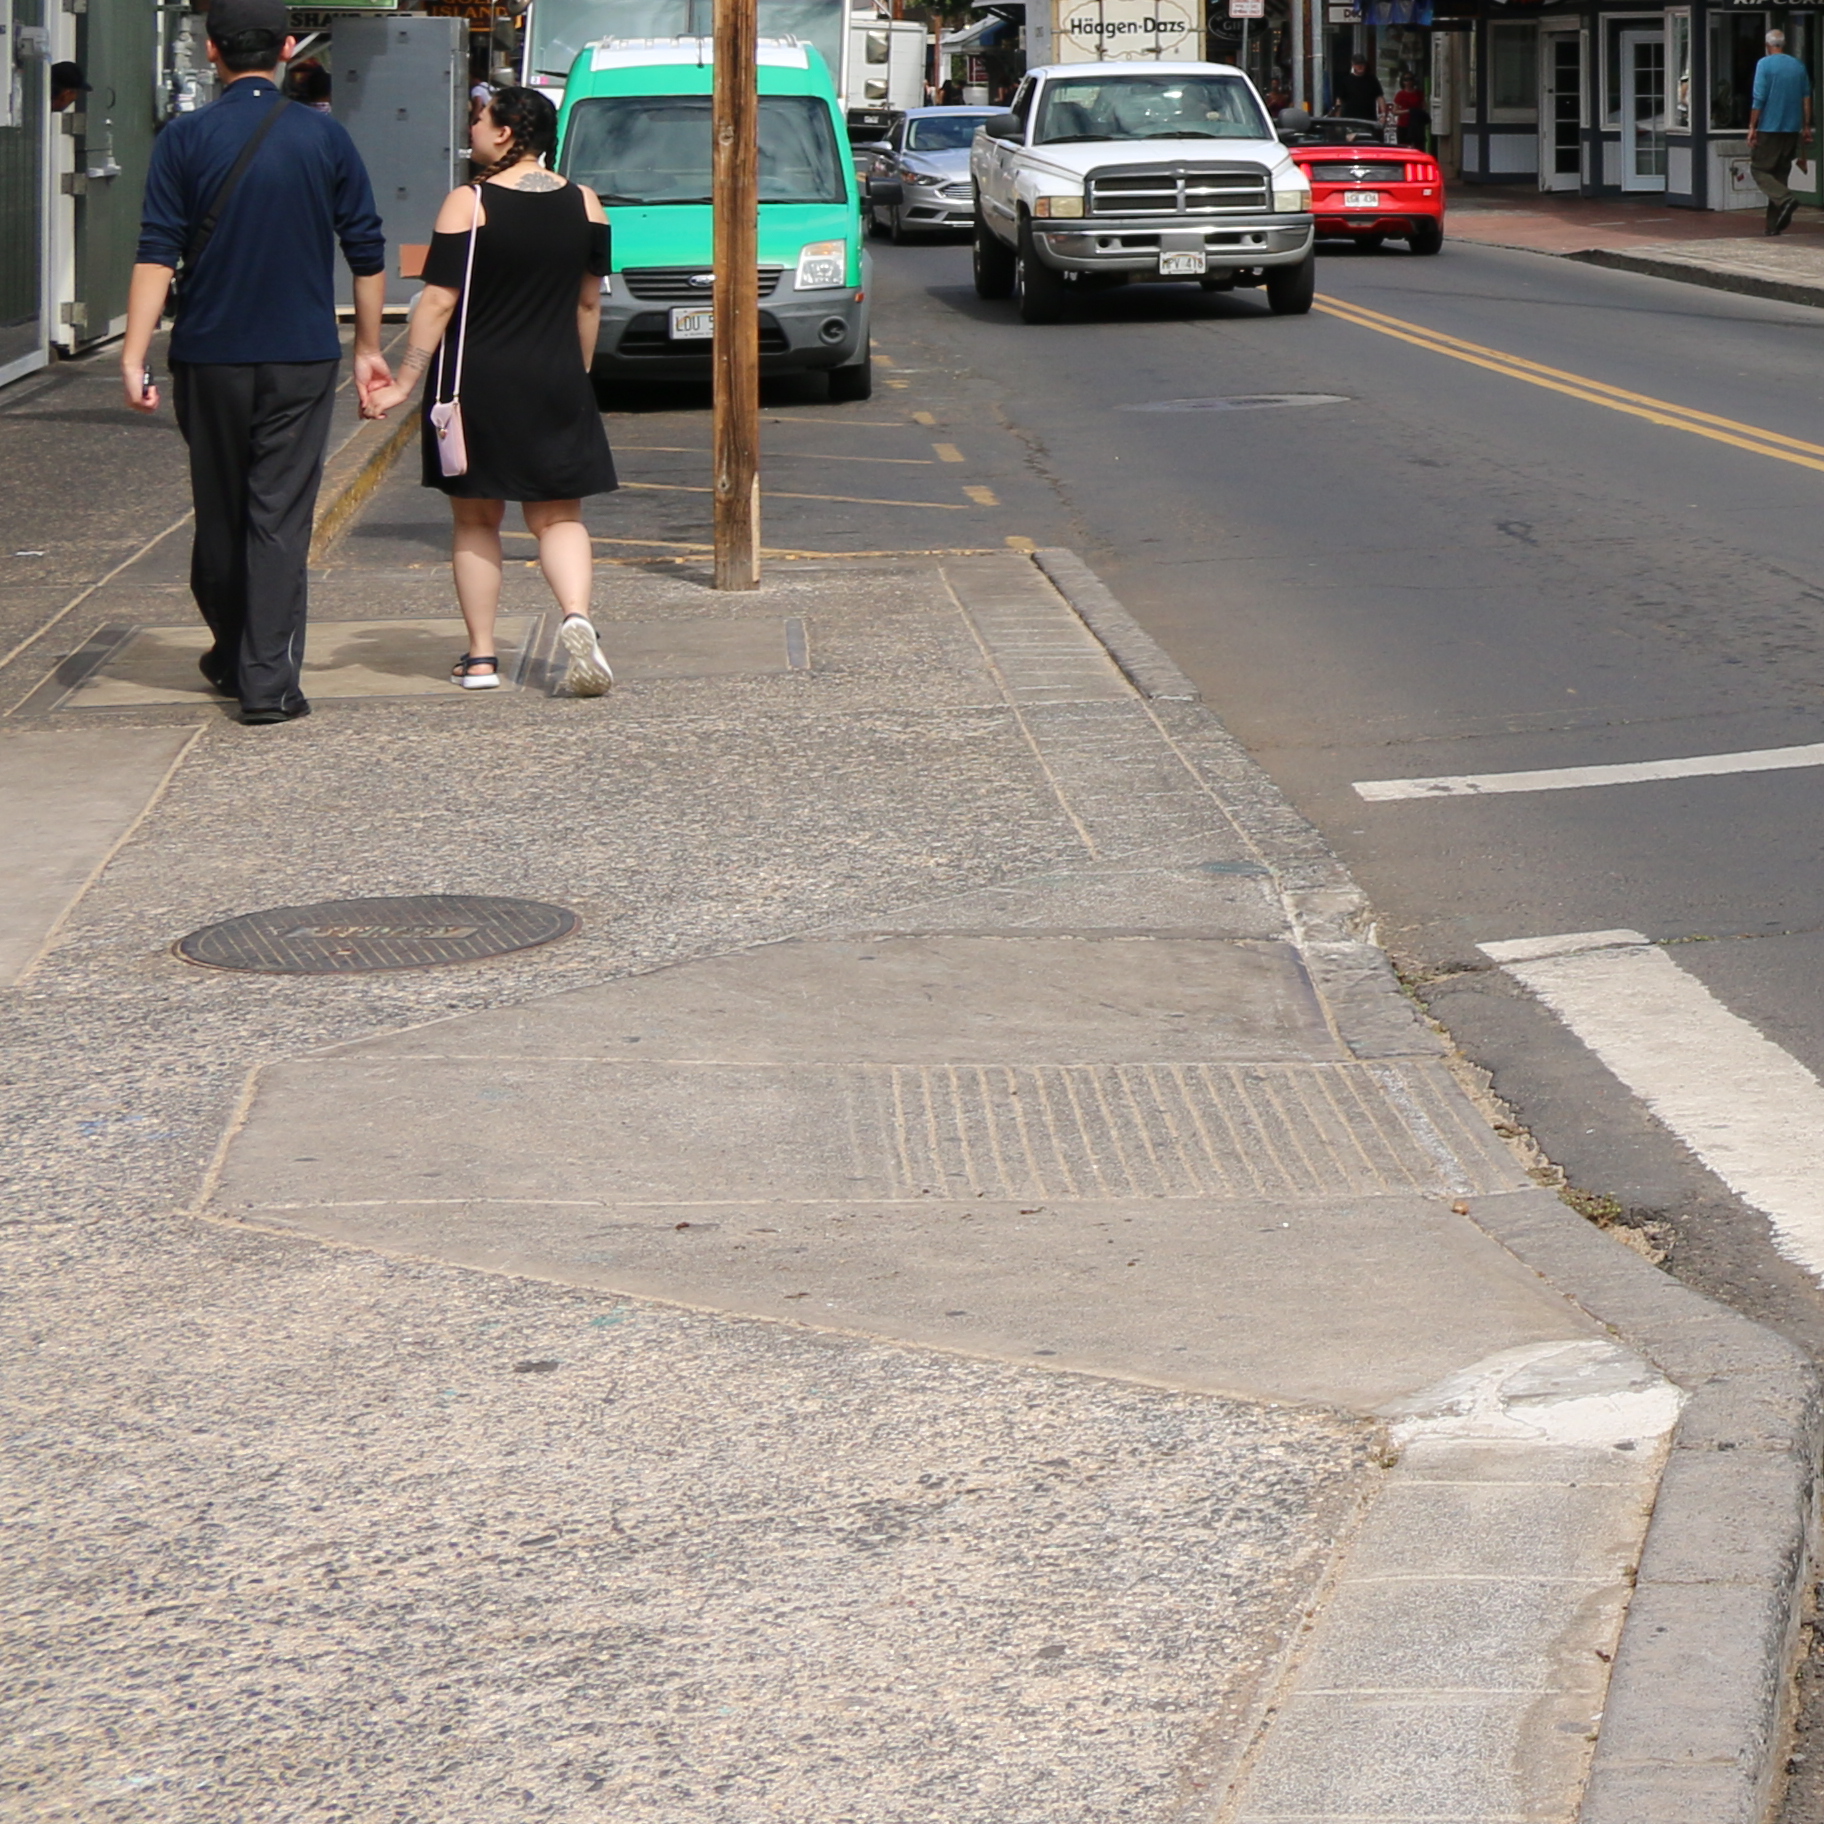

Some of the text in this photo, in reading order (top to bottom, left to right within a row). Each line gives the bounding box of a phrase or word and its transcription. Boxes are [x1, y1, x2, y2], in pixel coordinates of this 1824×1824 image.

[1071, 17, 1185, 39] Häagen-Dazs
[1162, 257, 1179, 269] MPV
[676, 316, 700, 331] LDU
